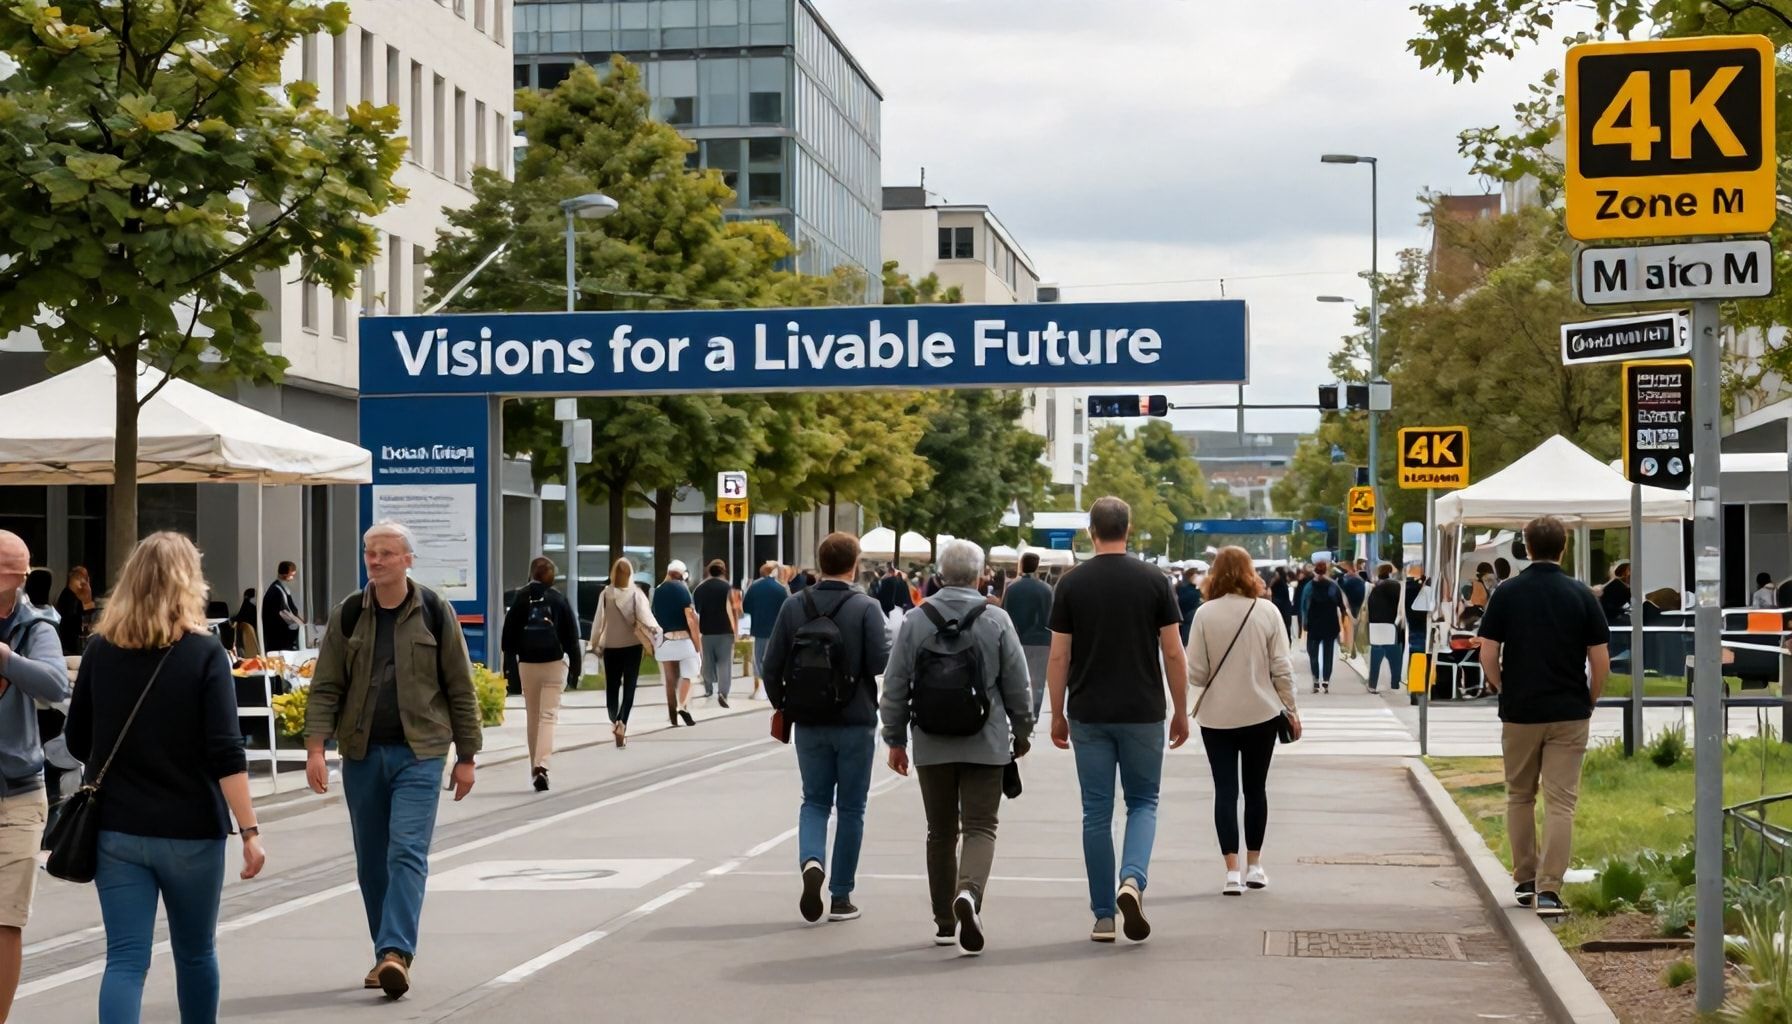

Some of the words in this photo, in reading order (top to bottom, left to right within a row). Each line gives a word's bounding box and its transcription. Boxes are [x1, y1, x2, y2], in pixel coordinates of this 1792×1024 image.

[1591, 66, 1748, 161] 4K
[1595, 191, 1698, 220] Zone
[1713, 188, 1744, 214] M
[392, 326, 595, 377] Visions
[609, 324, 690, 373] for
[704, 336, 735, 372] a
[754, 319, 956, 370] Livable
[974, 320, 1162, 366] Future
[1406, 433, 1457, 465] 4K
